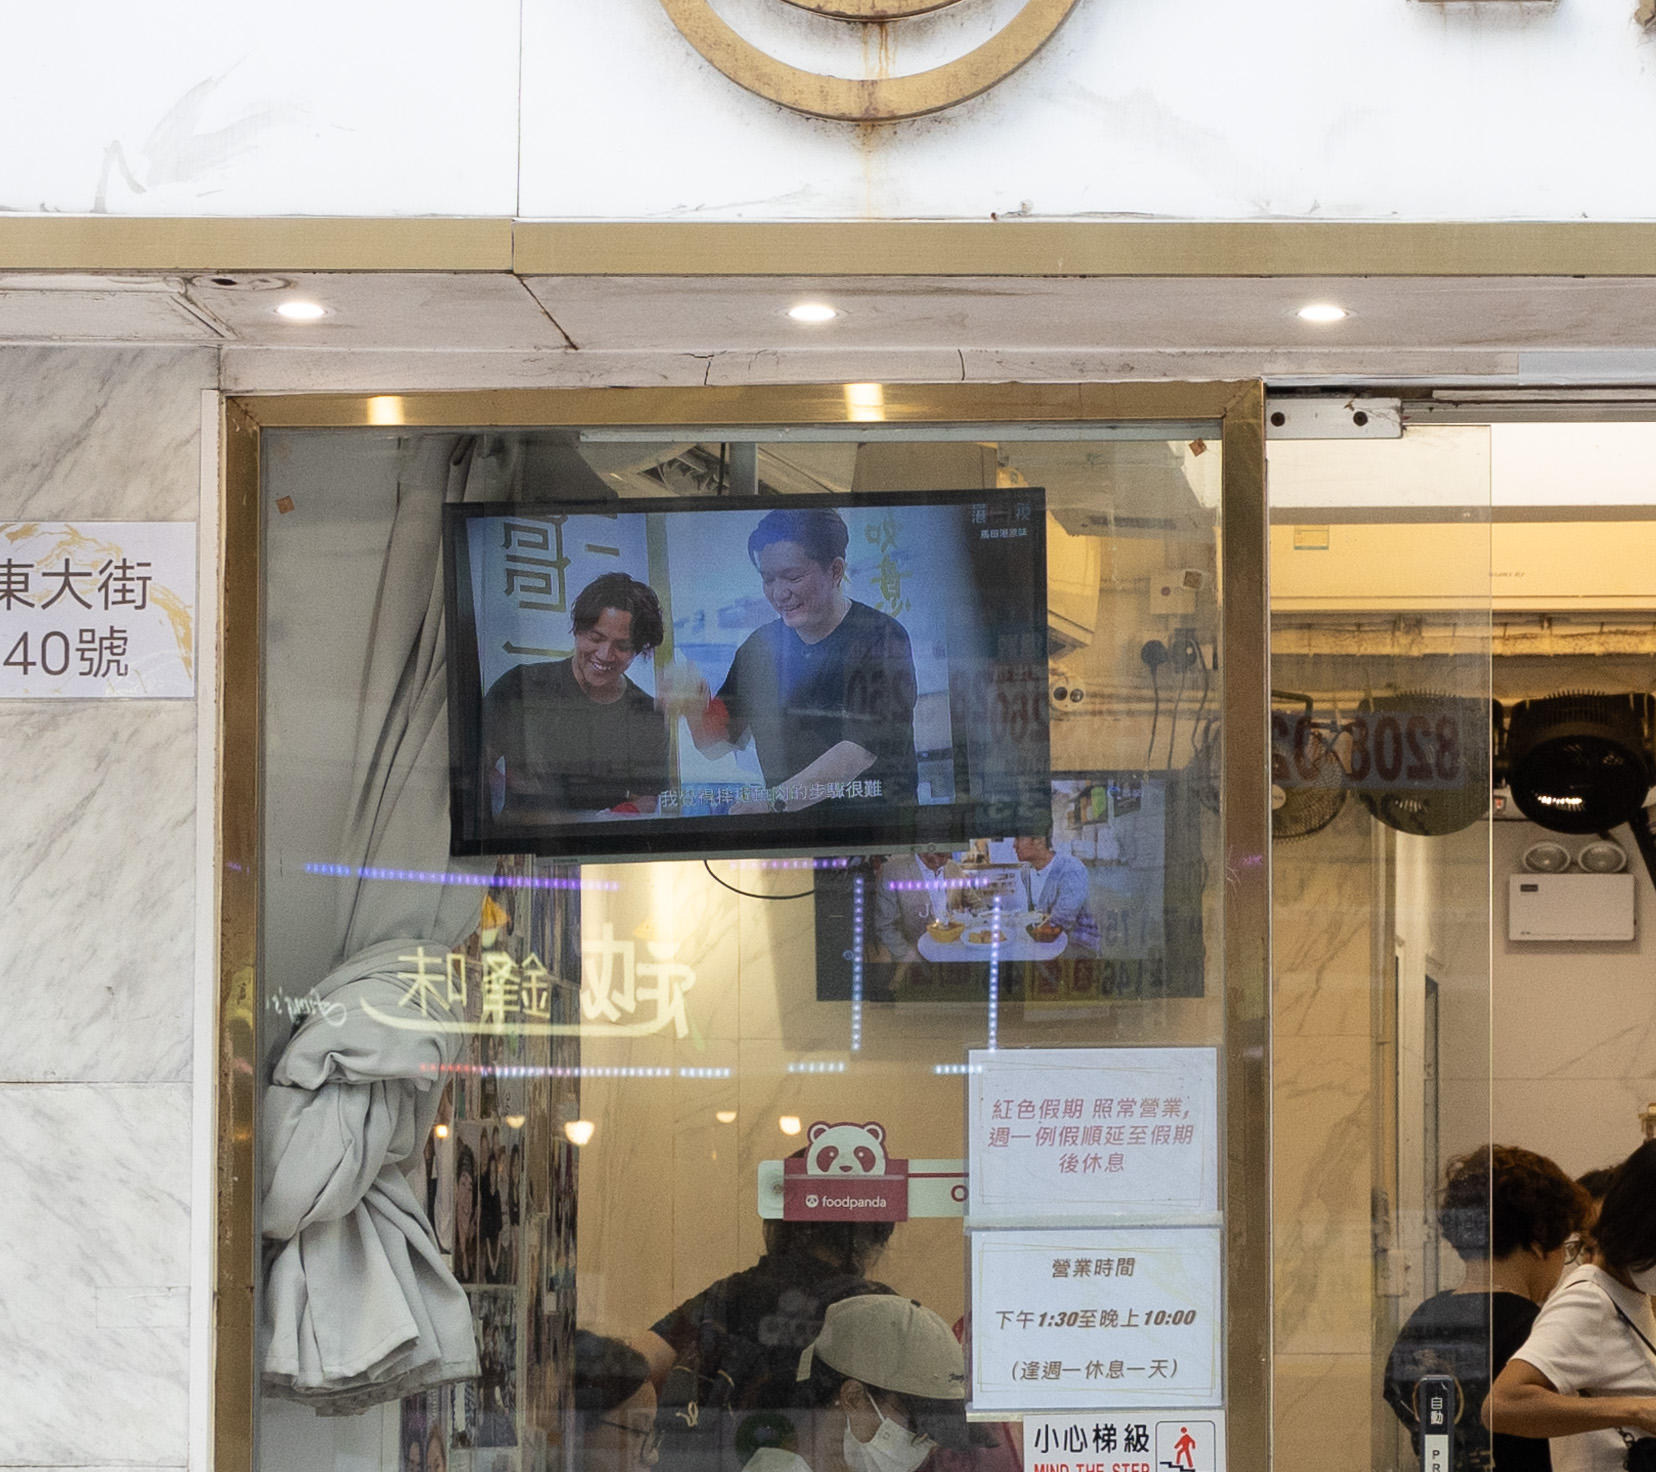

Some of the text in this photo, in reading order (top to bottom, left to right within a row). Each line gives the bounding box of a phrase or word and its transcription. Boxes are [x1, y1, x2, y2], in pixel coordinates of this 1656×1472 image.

[2, 629, 130, 679] 40號
[992, 1097, 1084, 1121] 紅色假期
[988, 1123, 1195, 1148] 週一例假順延至假期
[1058, 1151, 1125, 1176] 後休息
[822, 1194, 887, 1210] foodpanda
[1051, 1256, 1136, 1279] 營業時間
[1430, 1396, 1444, 1425] 自動
[1033, 1423, 1151, 1456] 小心梯級
